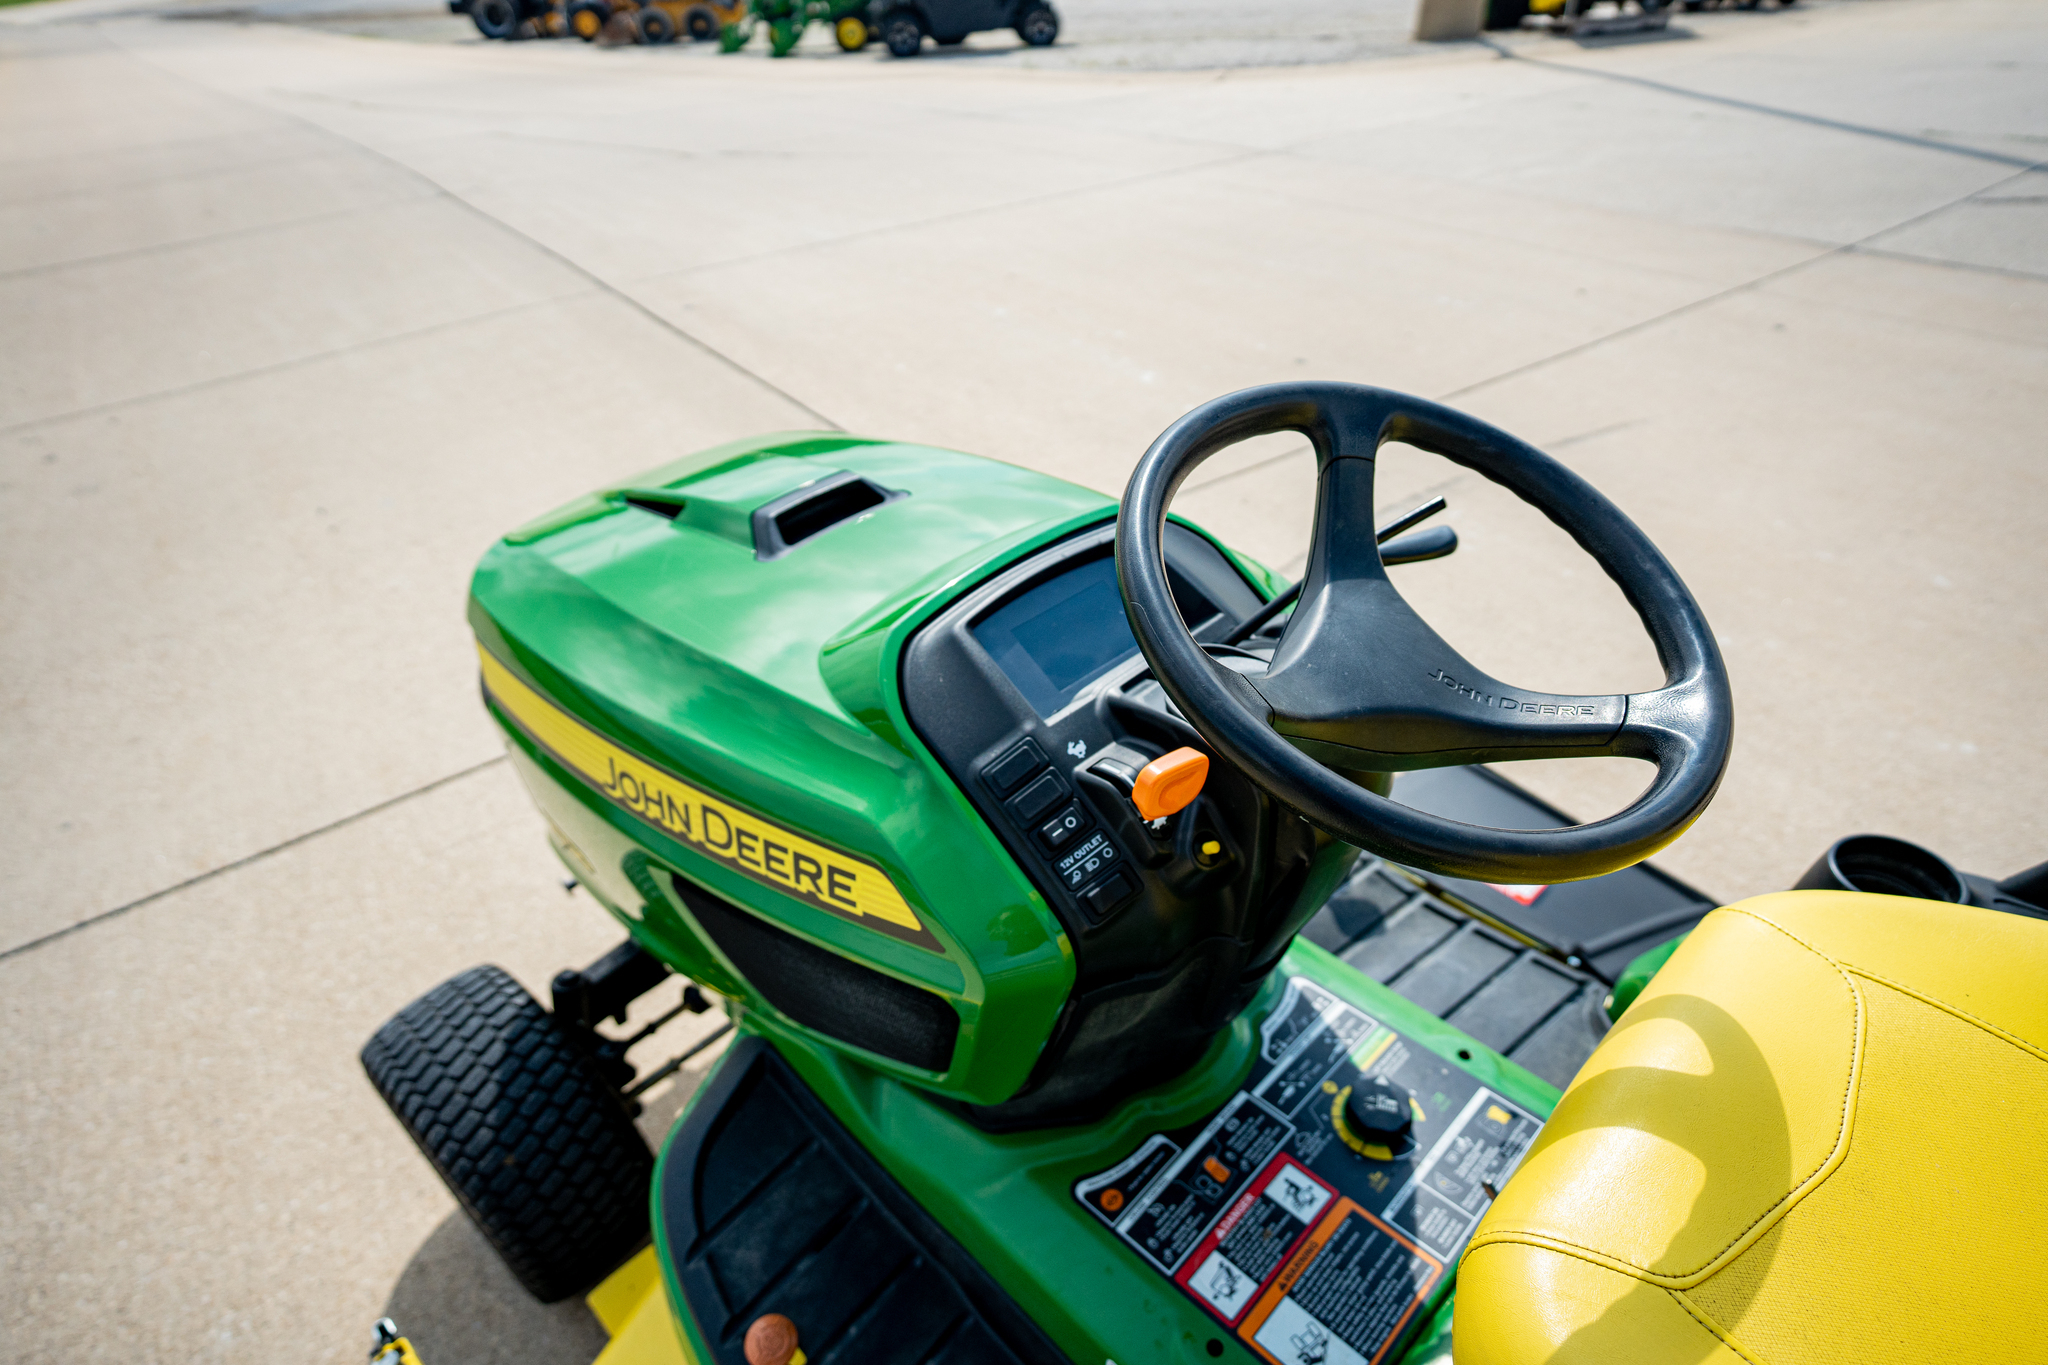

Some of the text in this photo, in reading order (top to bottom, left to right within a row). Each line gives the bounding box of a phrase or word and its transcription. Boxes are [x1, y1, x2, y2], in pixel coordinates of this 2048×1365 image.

[1428, 669, 1595, 716] JOHN DEERE
[605, 757, 692, 835] JOHN
[701, 803, 858, 909] DEERE
[1060, 834, 1103, 869] 12V OUTLET
[1219, 1192, 1256, 1231] DANGER
[1284, 1241, 1319, 1282] WARNING
